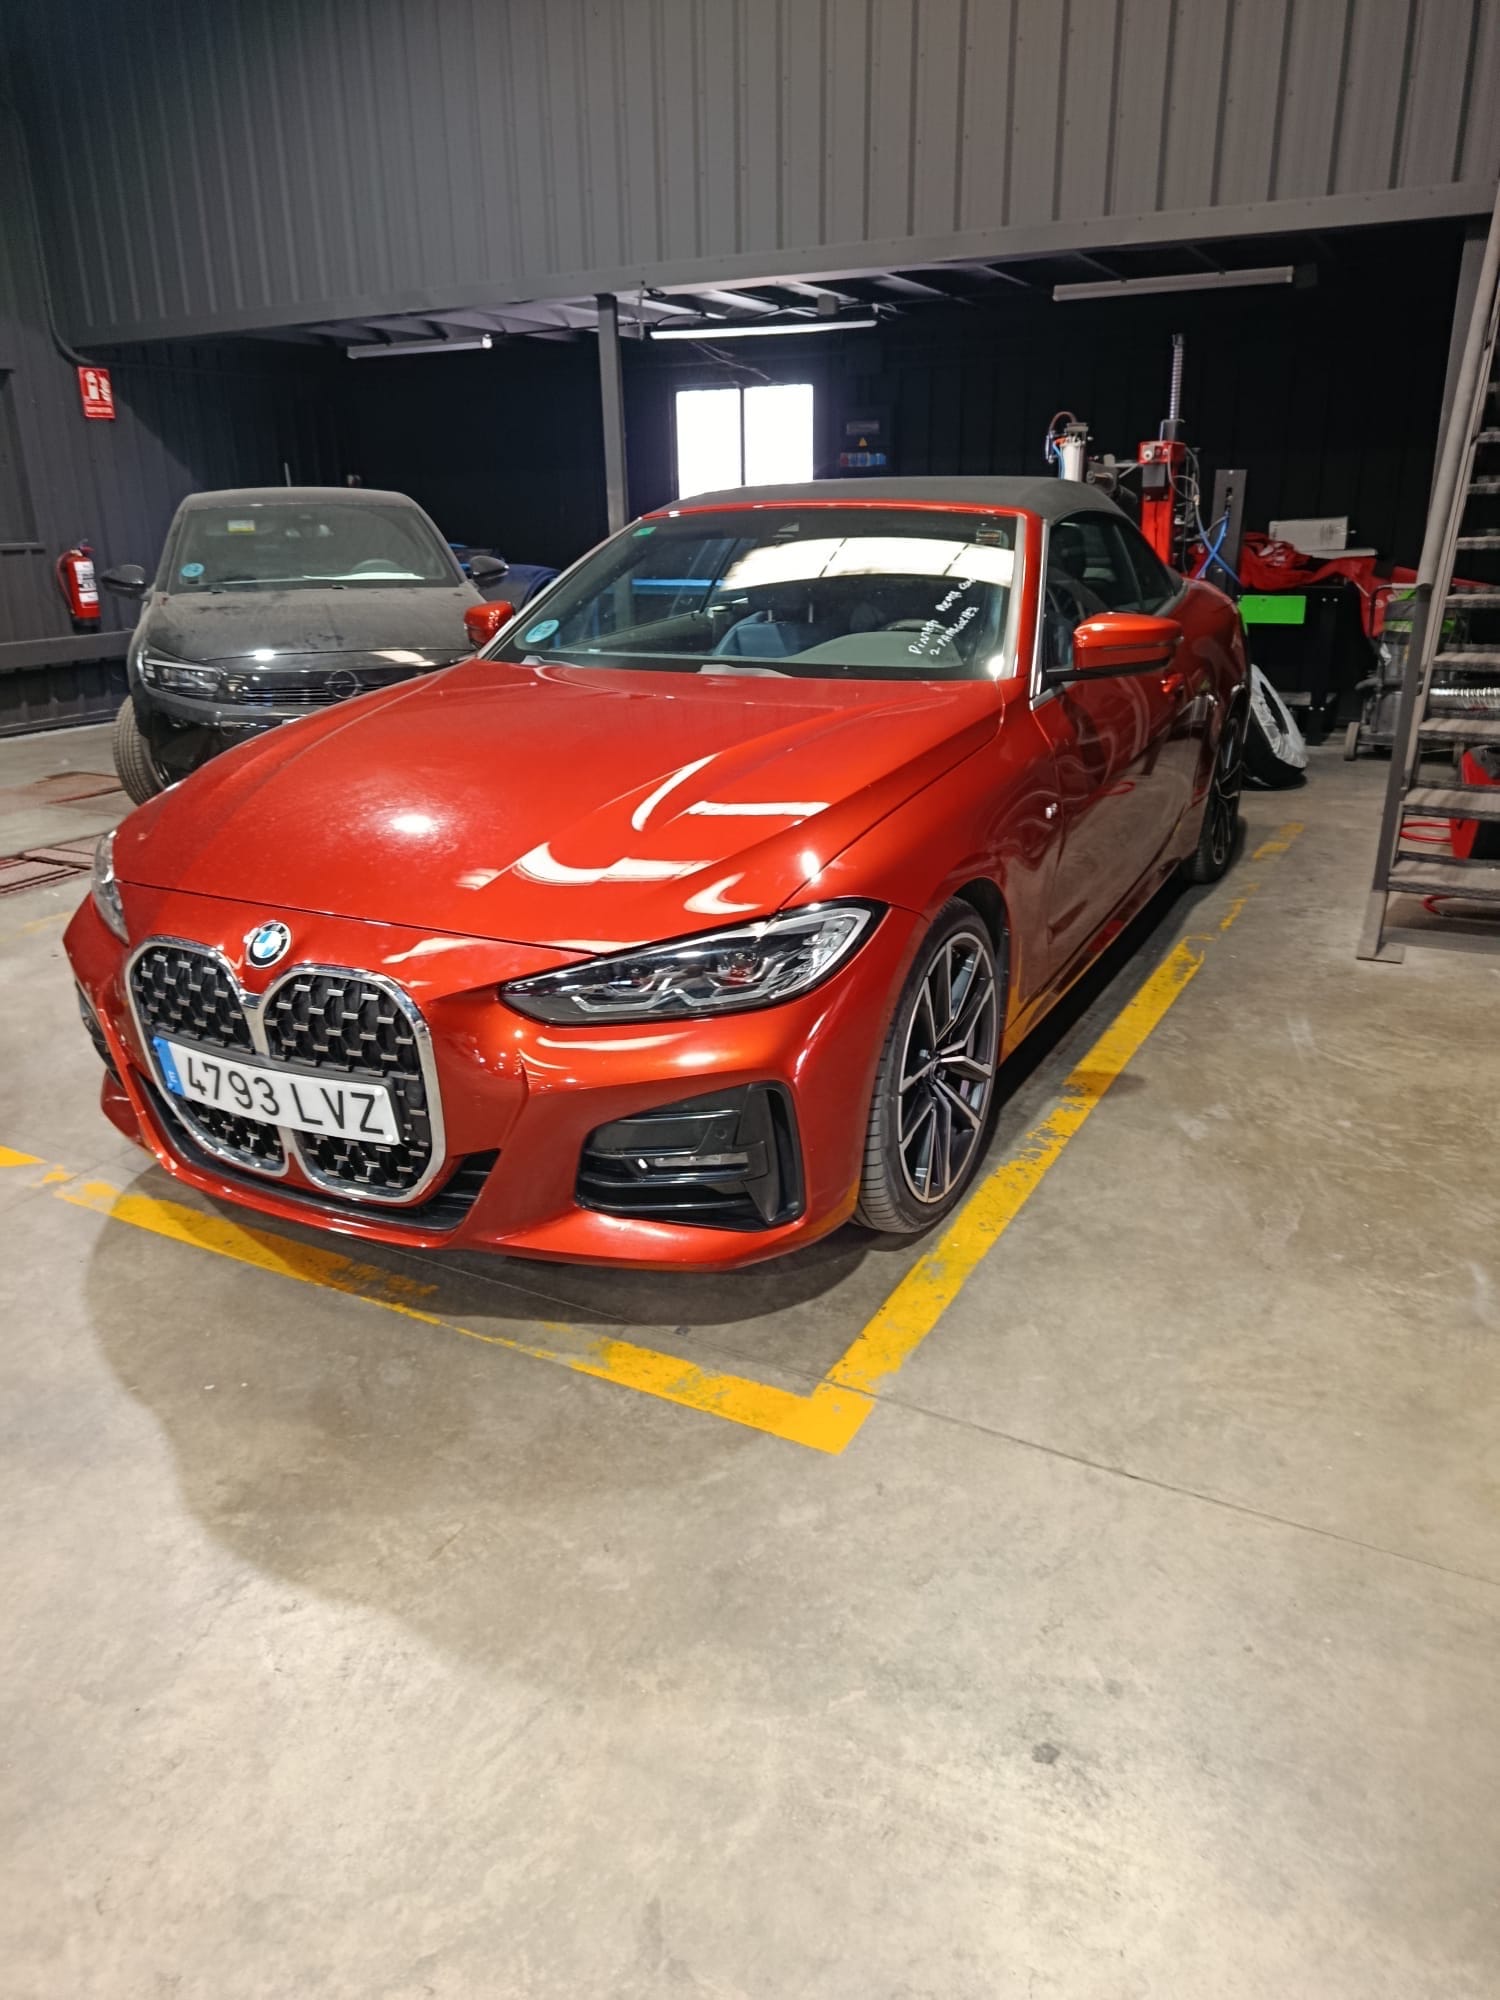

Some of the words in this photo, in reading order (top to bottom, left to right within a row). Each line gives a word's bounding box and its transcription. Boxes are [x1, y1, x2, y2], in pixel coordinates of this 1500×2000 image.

[929, 646, 941, 655] 2
[187, 1056, 280, 1116] 4793
[289, 1082, 385, 1135] LVZ
